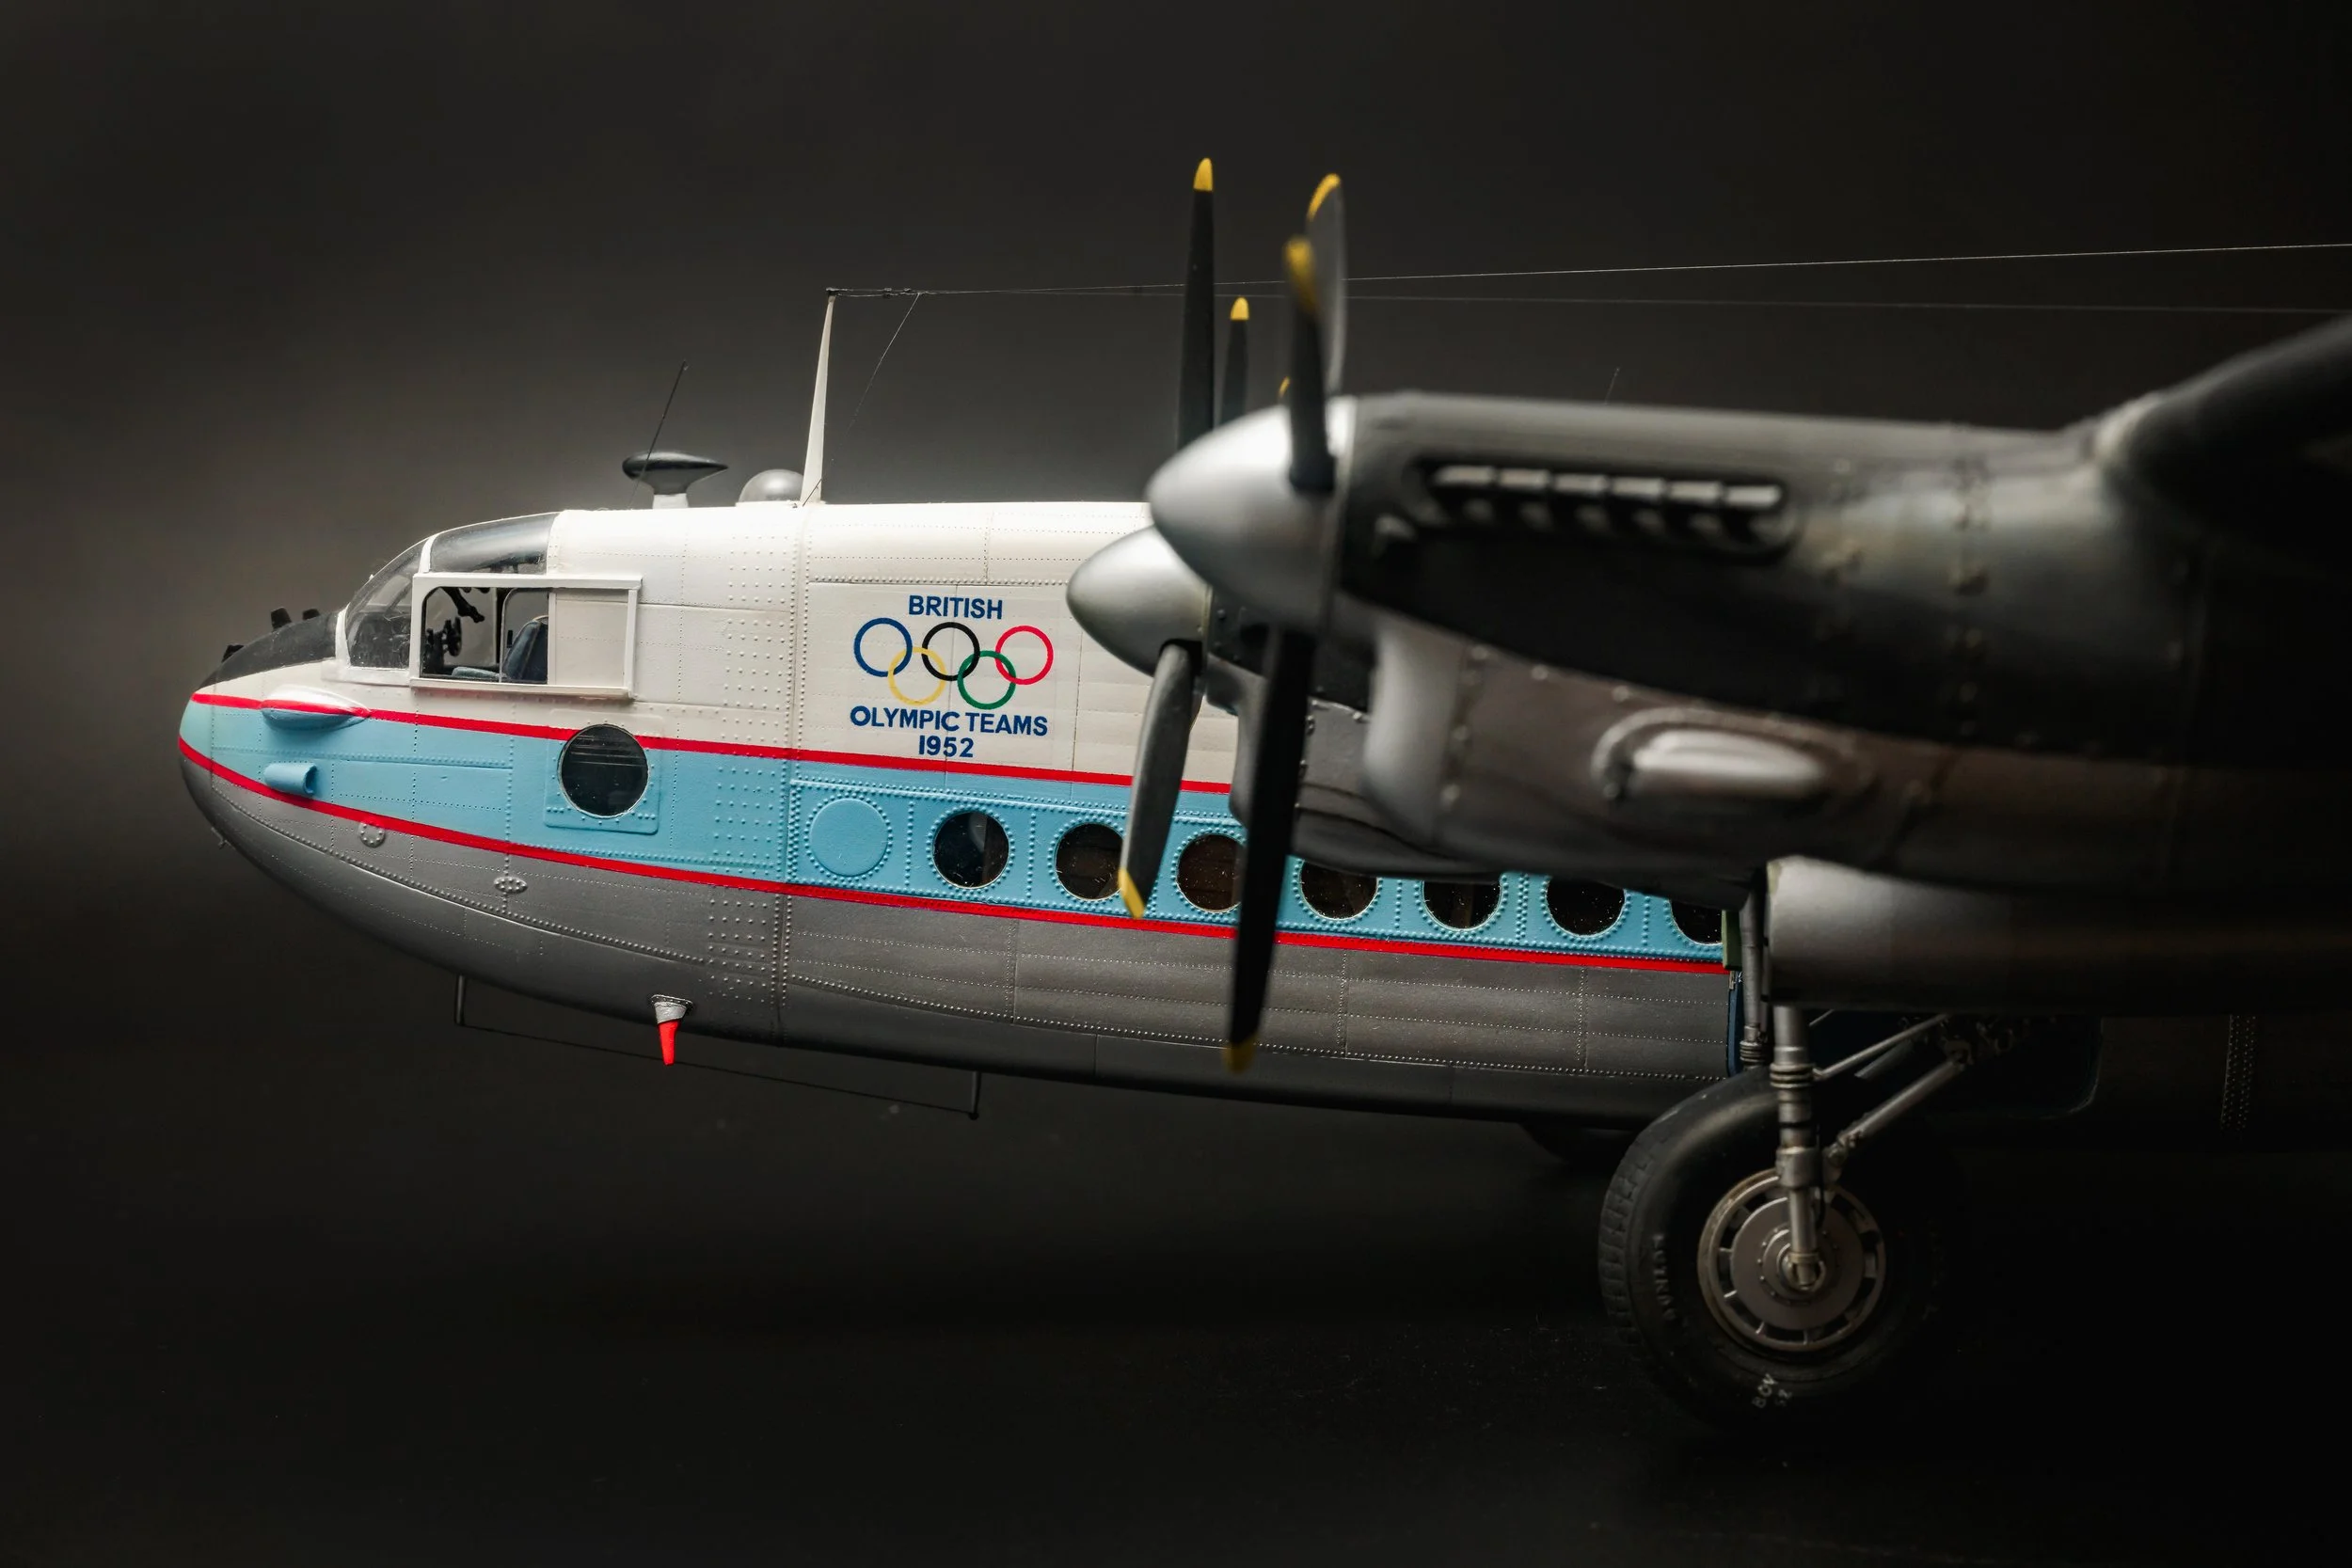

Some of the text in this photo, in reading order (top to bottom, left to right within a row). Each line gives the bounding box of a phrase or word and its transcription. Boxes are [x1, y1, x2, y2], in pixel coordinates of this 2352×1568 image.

[909, 595, 1002, 619] BRITISH
[850, 705, 1047, 736] OLYMPIC TEAMS
[919, 736, 974, 757] 1952
